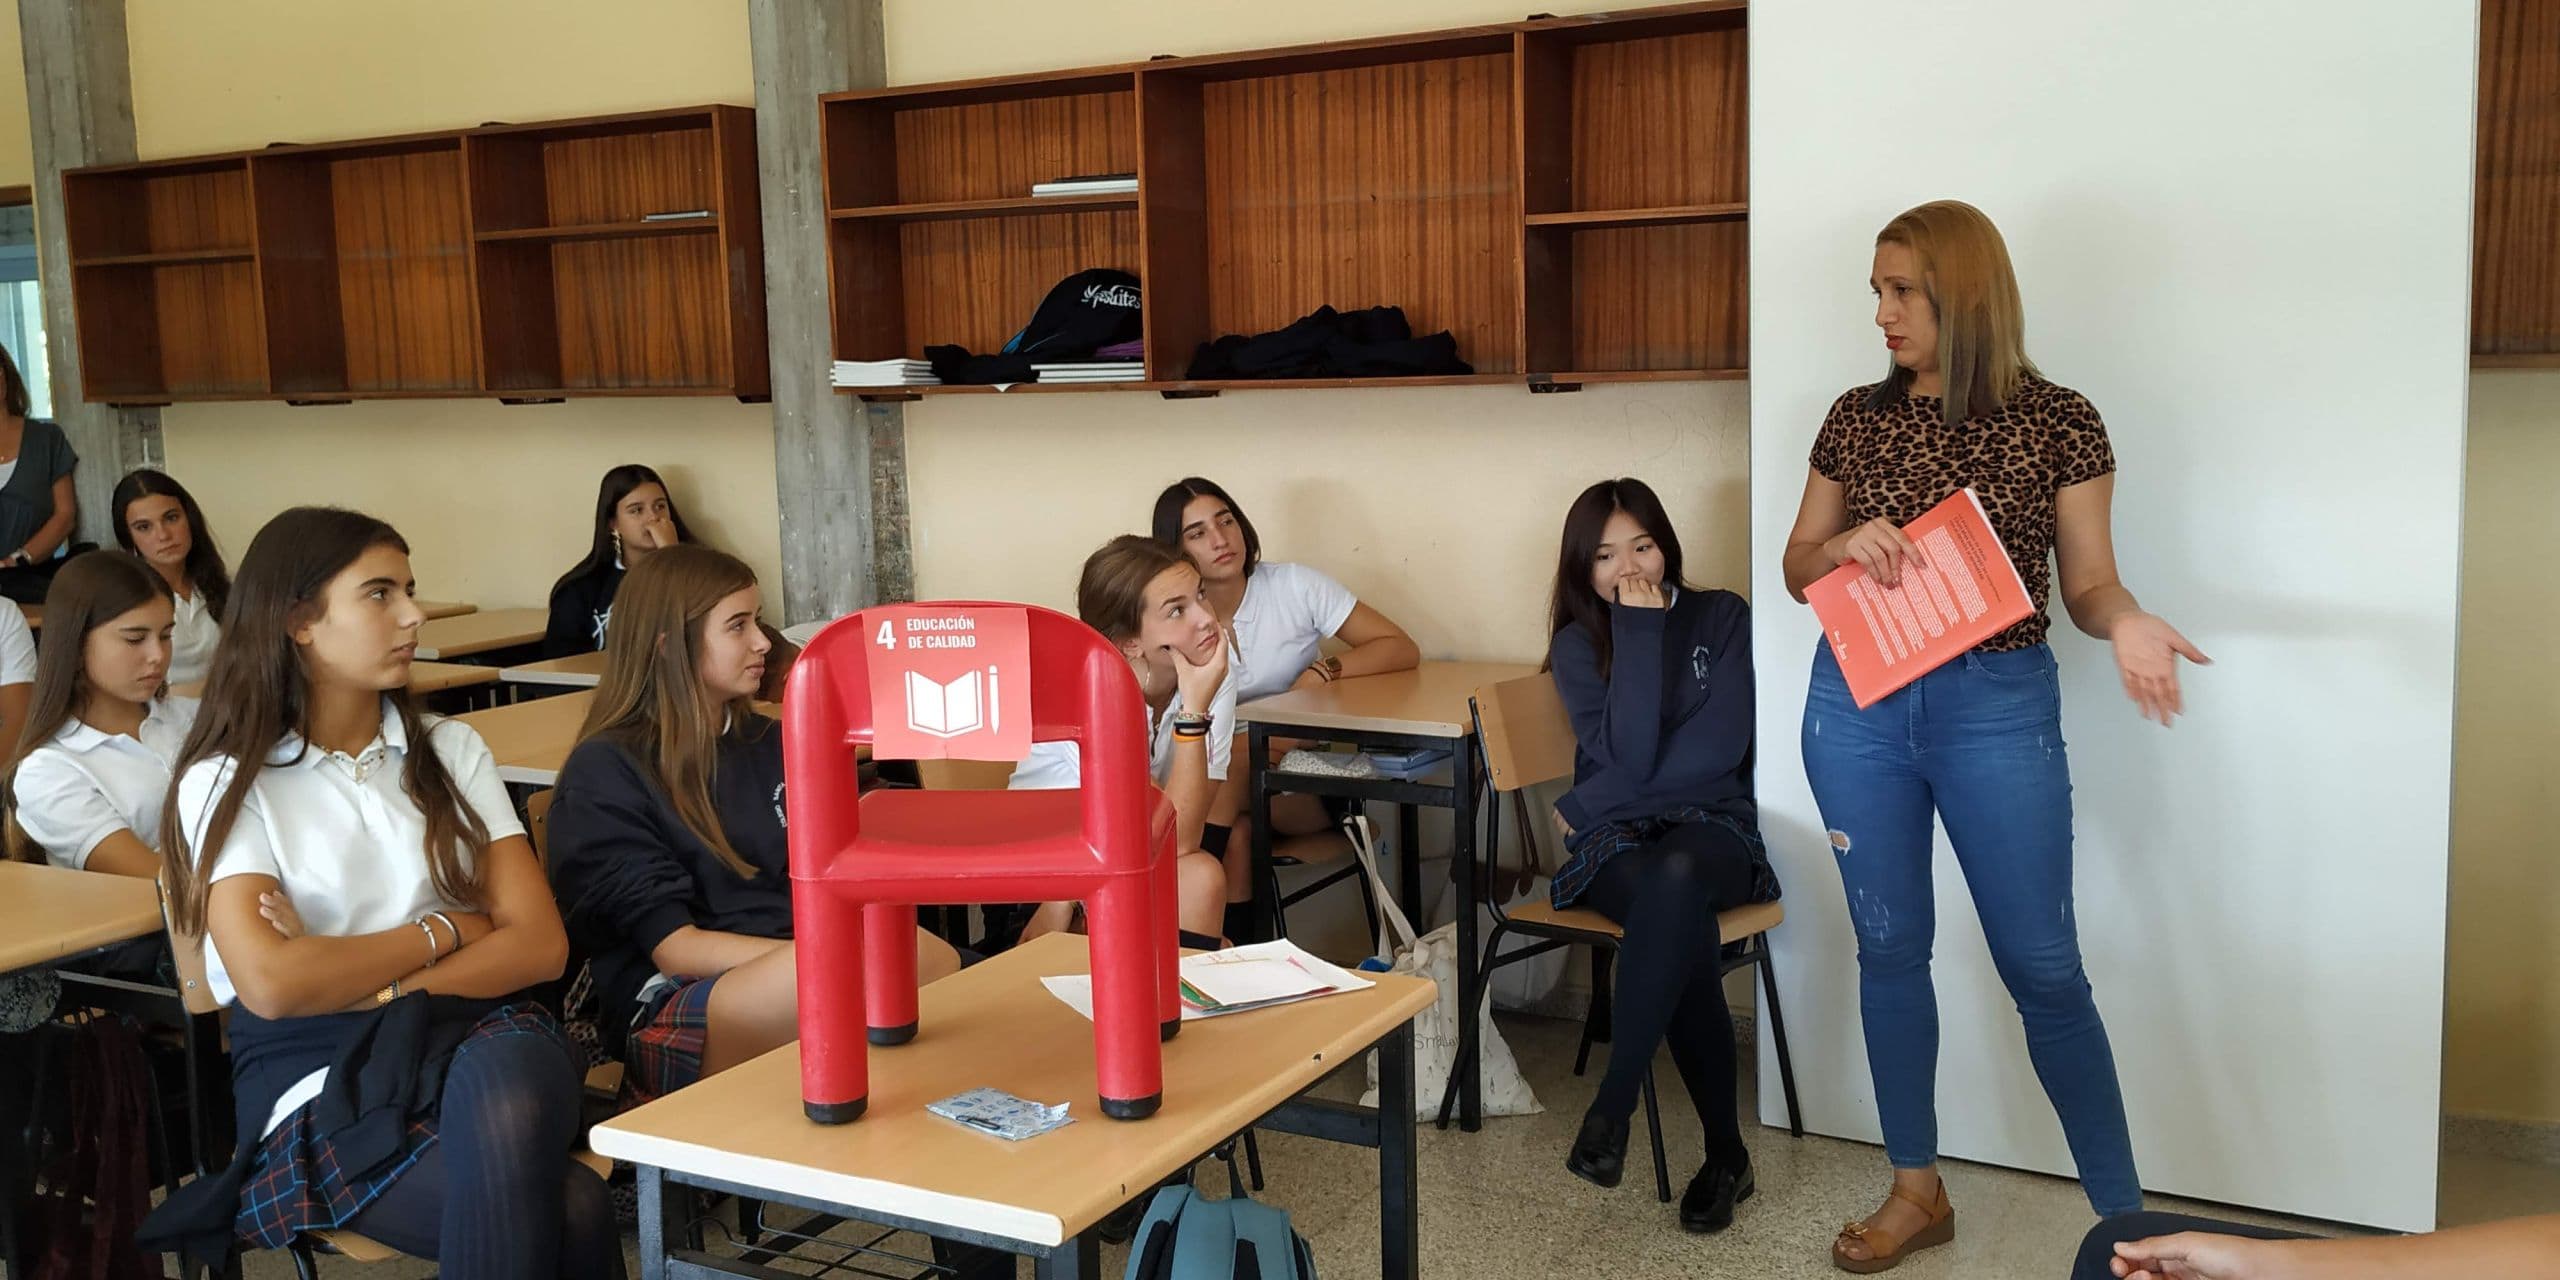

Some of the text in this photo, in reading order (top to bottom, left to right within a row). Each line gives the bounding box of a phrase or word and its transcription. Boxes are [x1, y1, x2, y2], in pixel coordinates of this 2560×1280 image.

[906, 615, 975, 631] EDUCACIÓN
[877, 620, 897, 650] 4
[908, 635, 976, 649] DE CALIDAD
